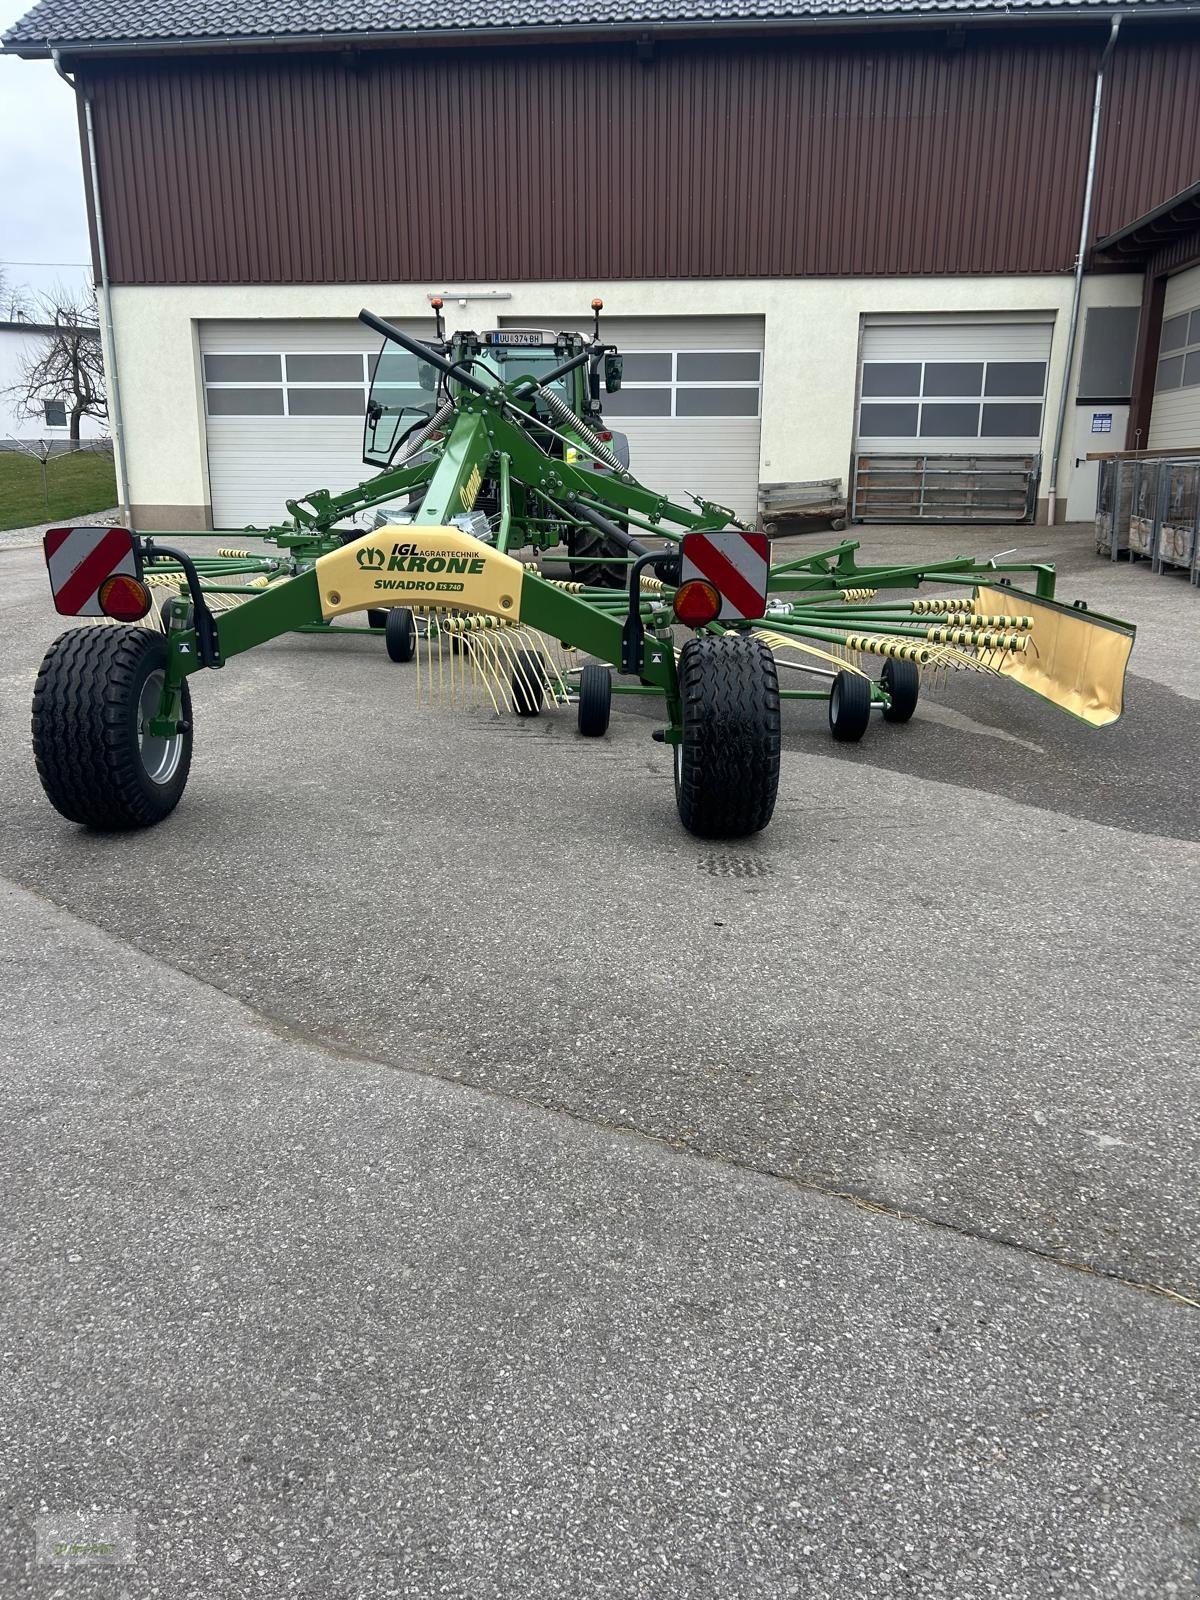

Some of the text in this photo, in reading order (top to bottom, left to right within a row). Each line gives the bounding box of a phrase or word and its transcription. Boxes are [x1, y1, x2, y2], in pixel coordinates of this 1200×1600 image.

[514, 334, 528, 342] 374
[391, 543, 480, 558] IGL AGRARTECHNIK
[387, 555, 486, 574] KRONE
[373, 579, 435, 591] SWADRO
